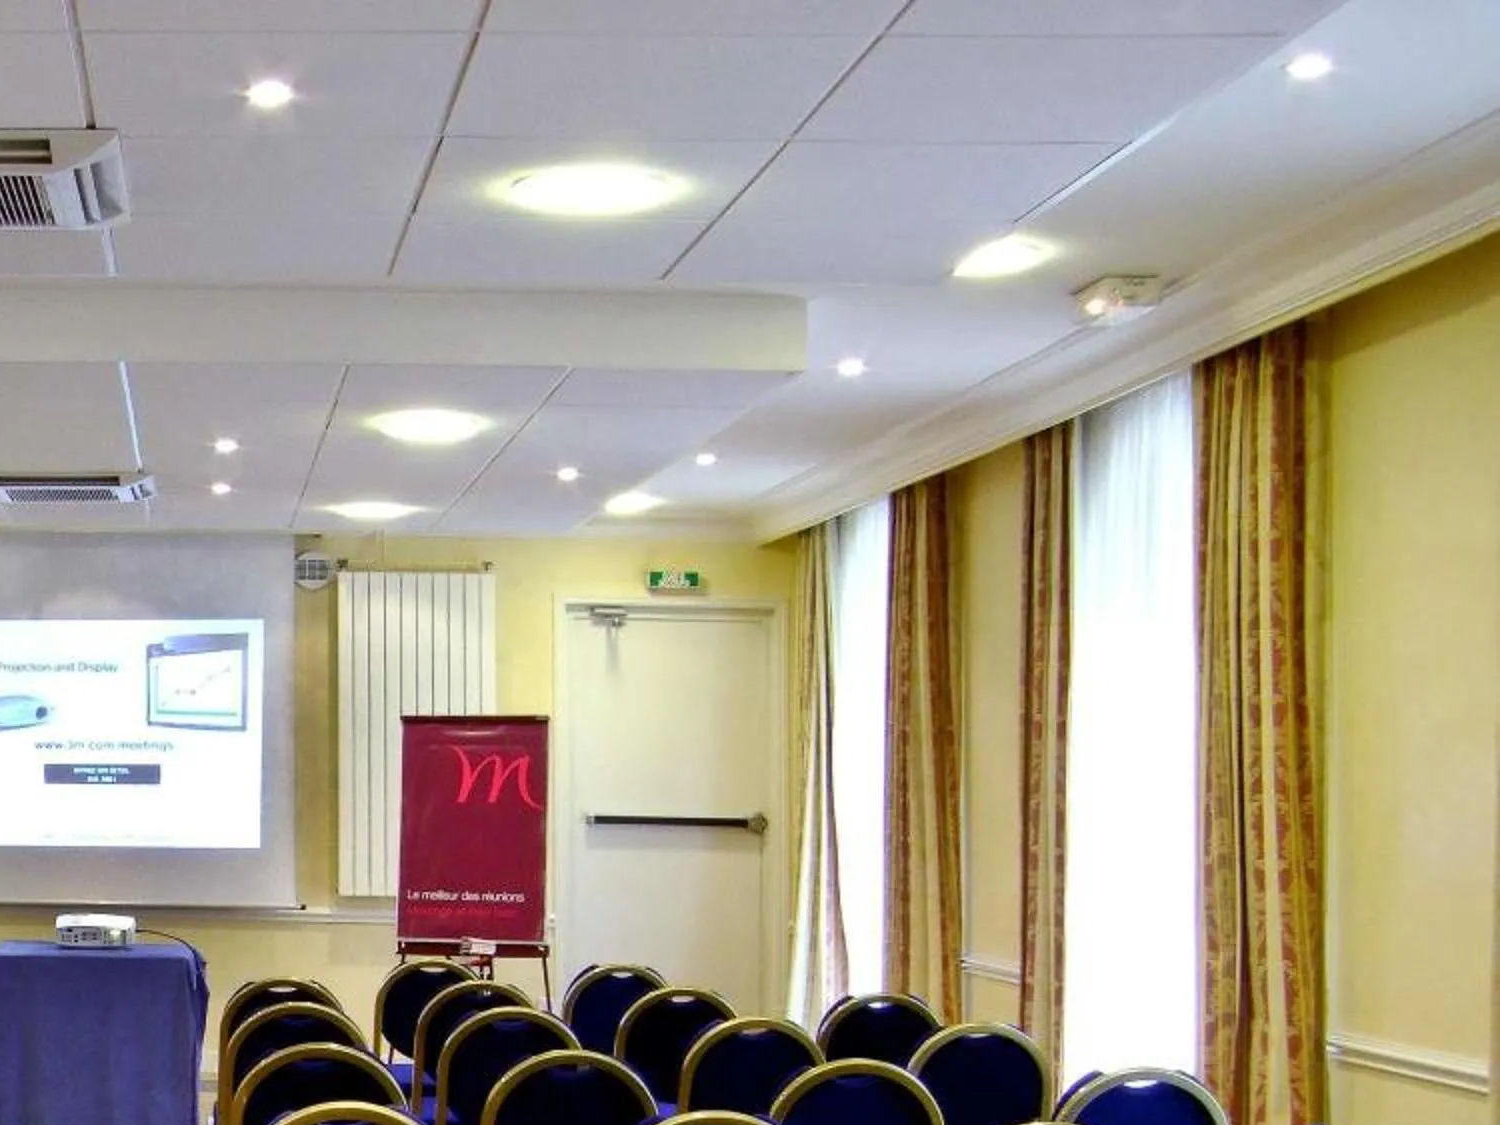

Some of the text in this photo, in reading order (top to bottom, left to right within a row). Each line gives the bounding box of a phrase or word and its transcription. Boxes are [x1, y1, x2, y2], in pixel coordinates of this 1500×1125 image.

[53, 661, 75, 673] and
[77, 660, 119, 674] Display
[406, 888, 420, 901] Le
[461, 890, 481, 902] des
